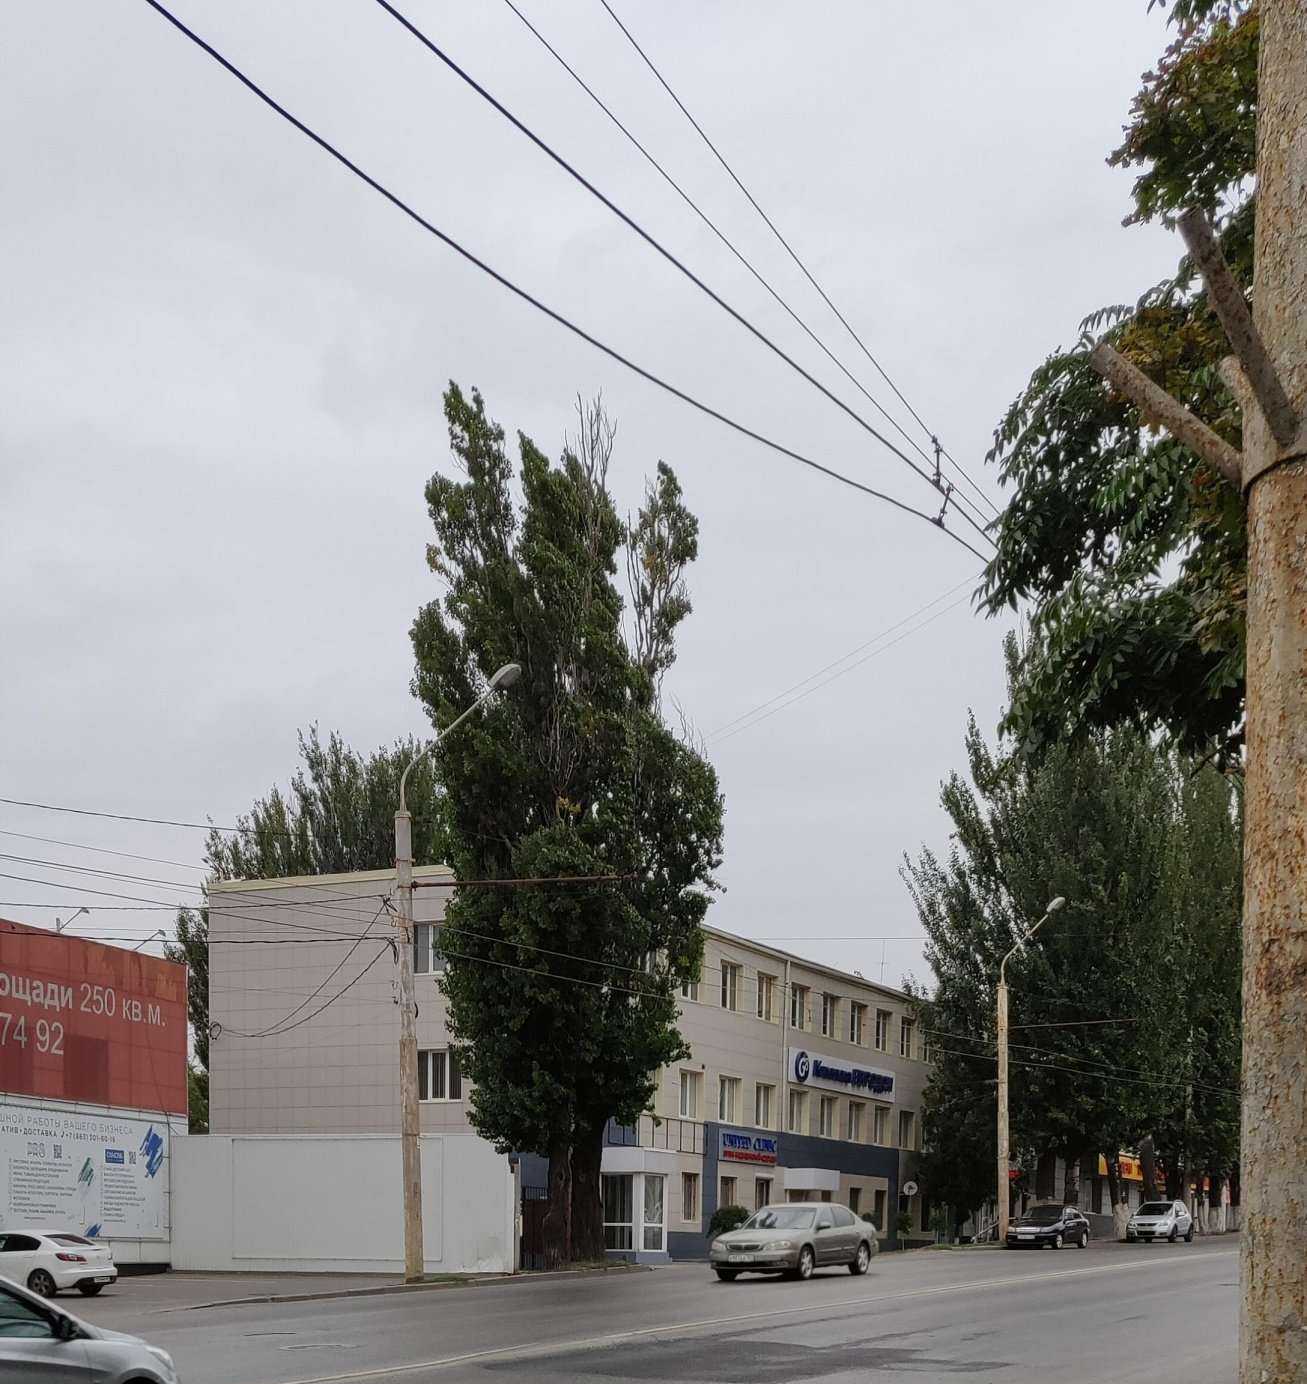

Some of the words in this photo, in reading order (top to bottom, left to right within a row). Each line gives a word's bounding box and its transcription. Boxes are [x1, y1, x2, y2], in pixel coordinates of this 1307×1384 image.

[80, 983, 116, 1016] 250
[122, 998, 167, 1027] кв.м.
[0, 1012, 29, 1049] 74
[36, 1019, 65, 1055] 92
[26, 1115, 61, 1129] РАБОТЫ
[63, 1119, 97, 1131] ВАШЕГО
[99, 1123, 134, 1135] БИЗНЕСА
